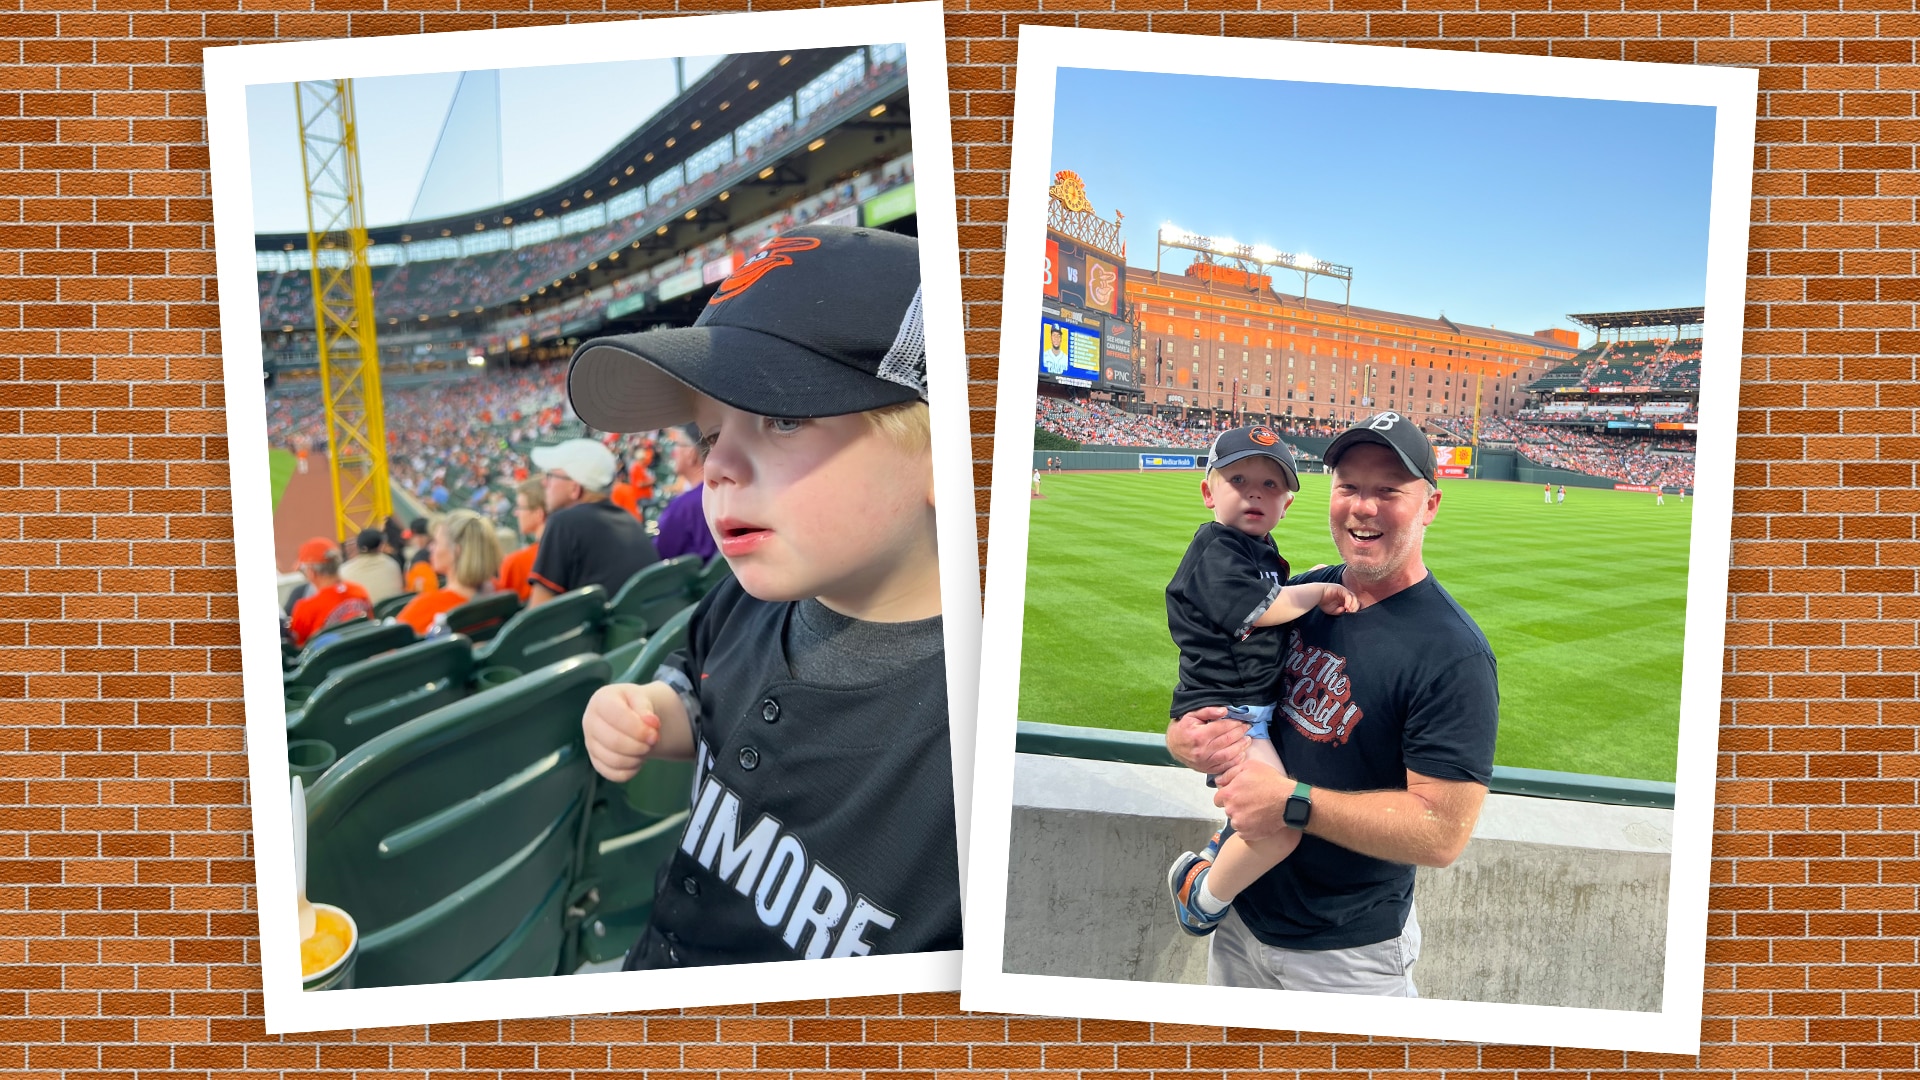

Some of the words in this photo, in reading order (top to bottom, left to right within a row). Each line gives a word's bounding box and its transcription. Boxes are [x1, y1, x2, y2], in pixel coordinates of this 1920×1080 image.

[1067, 266, 1078, 283] VS
[1114, 370, 1130, 382] PNC
[1369, 411, 1400, 430] B
[1315, 652, 1347, 696] The
